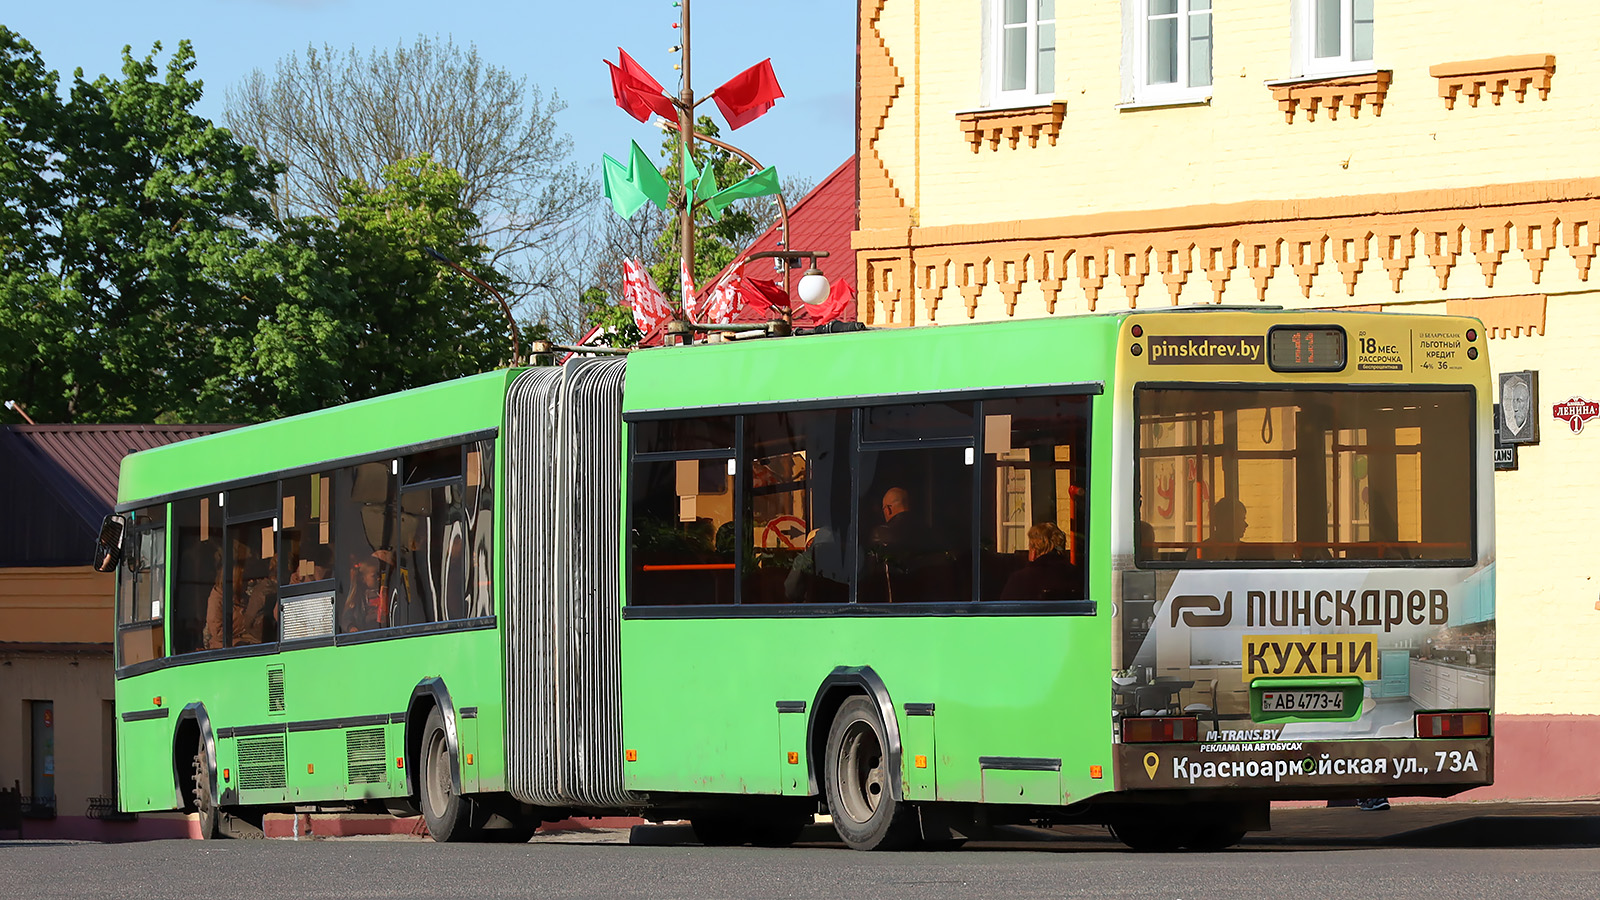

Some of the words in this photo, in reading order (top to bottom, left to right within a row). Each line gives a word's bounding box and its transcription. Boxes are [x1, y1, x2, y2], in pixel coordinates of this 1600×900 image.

[1151, 339, 1261, 361] pinskdrev.by
[1292, 332, 1315, 363] 11
[1359, 337, 1377, 354] 18
[1378, 345, 1399, 354] МЕС.
[1420, 339, 1461, 349] ЛЬГОТНЫЙ
[1358, 355, 1402, 363] РАССРОЧКА
[1426, 350, 1456, 359] КРЕДИТ
[1437, 361, 1448, 370] 36
[1556, 405, 1596, 416] ЛЕНИНА
[1573, 416, 1579, 432] 1
[1247, 641, 1372, 675] КУХНИ
[1275, 693, 1295, 709] AB
[1298, 693, 1342, 709] 4773-4
[1206, 729, 1280, 741] M-TRANS.BY
[1200, 743, 1241, 753] РЕКЛАМА
[1241, 743, 1254, 752] НА
[1254, 742, 1303, 751] АВТОБУСАХ
[1392, 757, 1429, 780] ул.,
[1434, 750, 1479, 773] 73А
